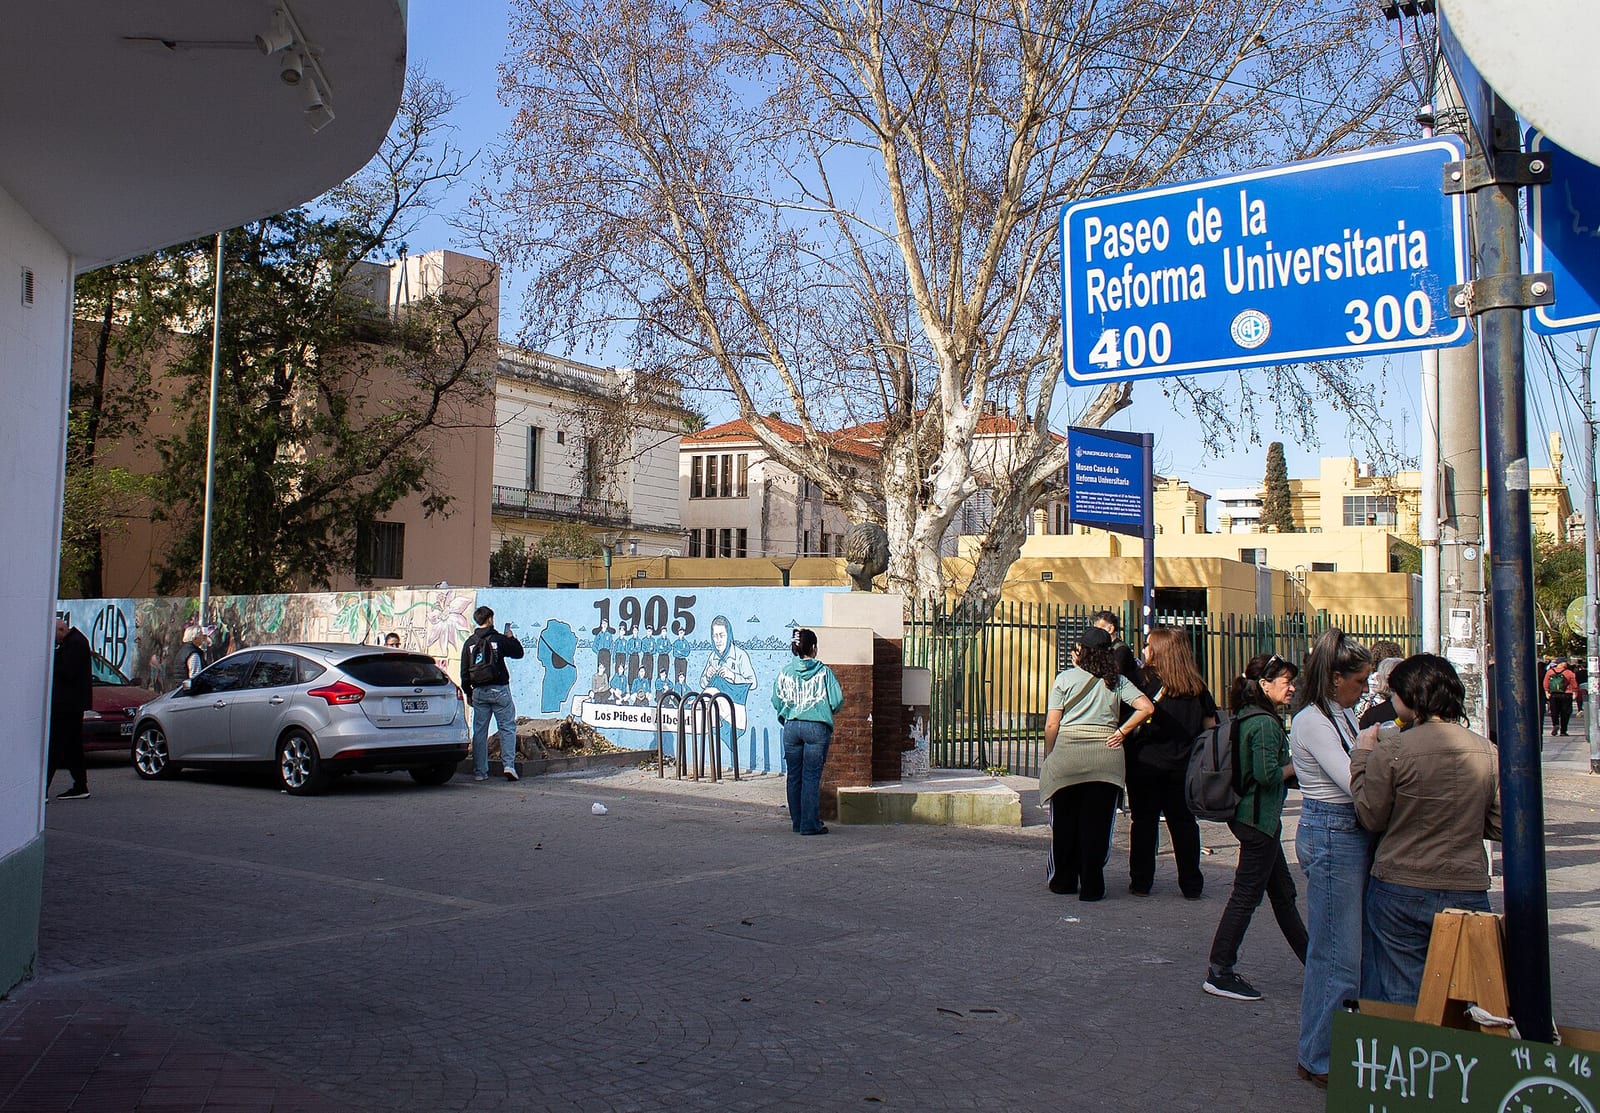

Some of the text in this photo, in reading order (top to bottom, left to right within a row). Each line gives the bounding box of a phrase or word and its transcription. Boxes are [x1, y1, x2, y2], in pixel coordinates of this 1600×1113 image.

[1084, 189, 1268, 263] Paseo de la
[1086, 219, 1429, 315] Reforma Universitaria
[1344, 289, 1432, 344] 300
[1088, 321, 1172, 369] 400
[1075, 463, 1119, 474] Museo Casa de la
[1075, 474, 1130, 486] Reforma Universitaria
[592, 594, 697, 637] 1905
[594, 710, 611, 721] Los
[613, 711, 638, 723] Pibes
[640, 712, 652, 724] de
[1351, 1038, 1479, 1104] HAPPY
[1511, 1046, 1593, 1078] 14 a 16
